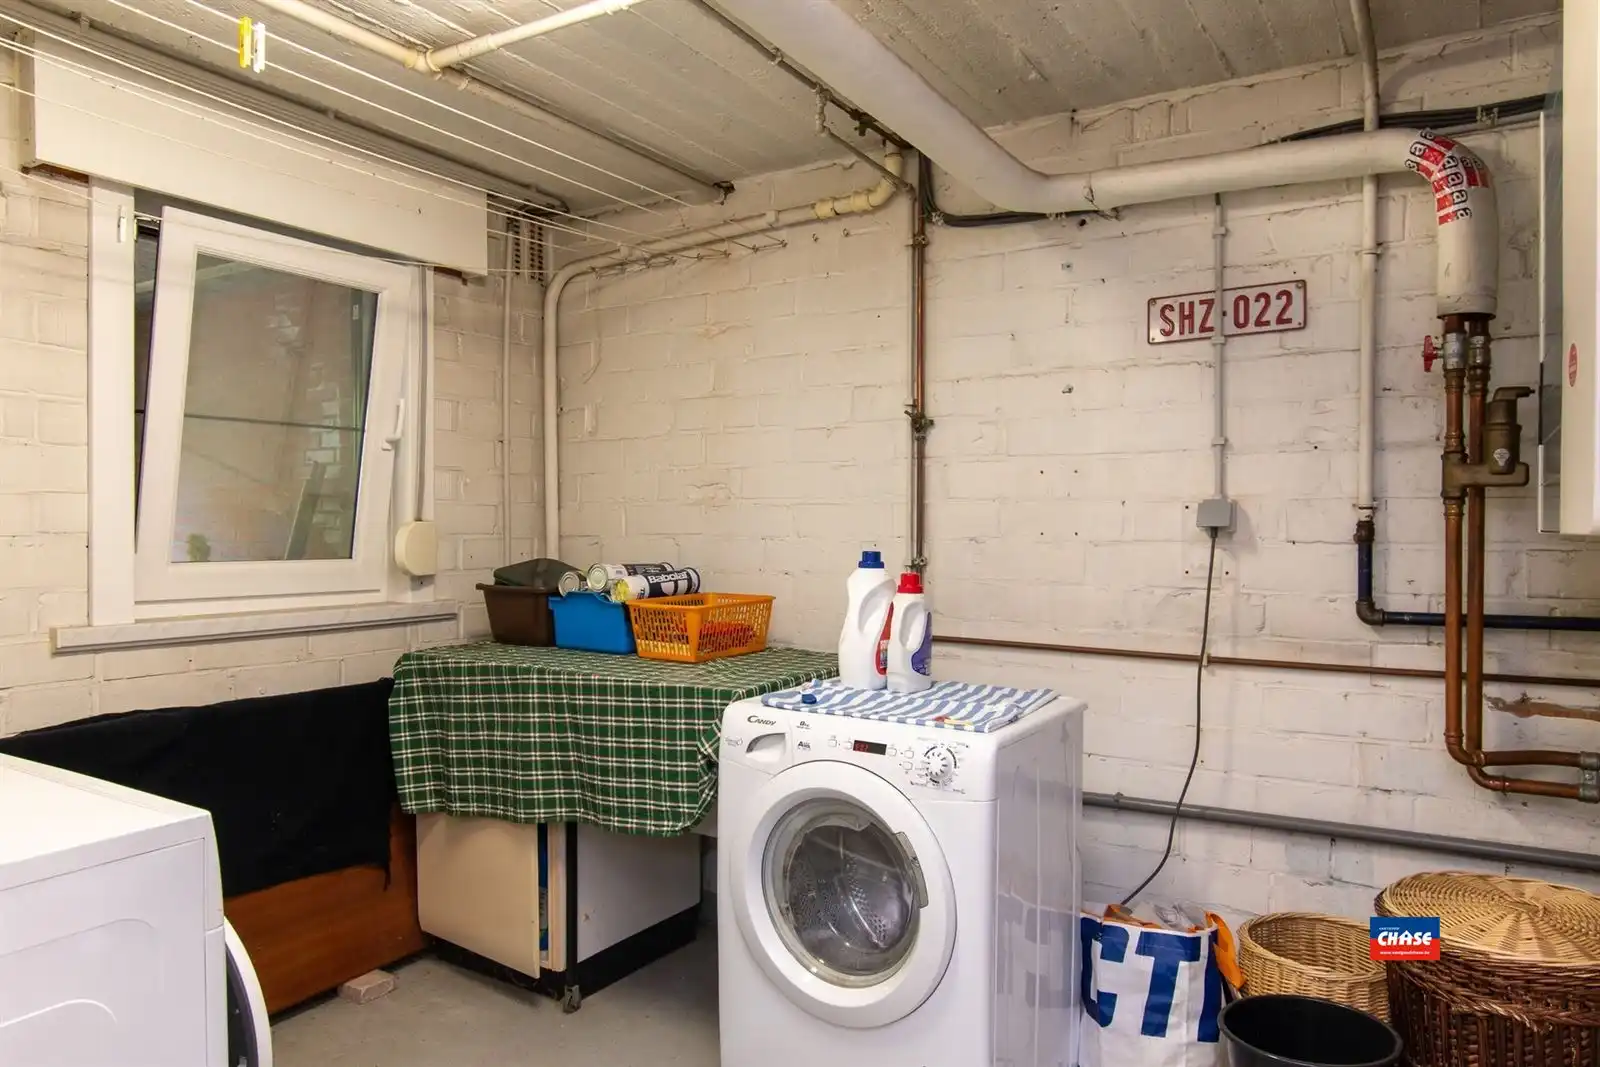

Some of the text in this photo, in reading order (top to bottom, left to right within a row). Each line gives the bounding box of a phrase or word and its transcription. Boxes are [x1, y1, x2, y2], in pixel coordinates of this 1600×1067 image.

[1159, 289, 1293, 337] SHZ 022
[747, 715, 777, 726] CANDY
